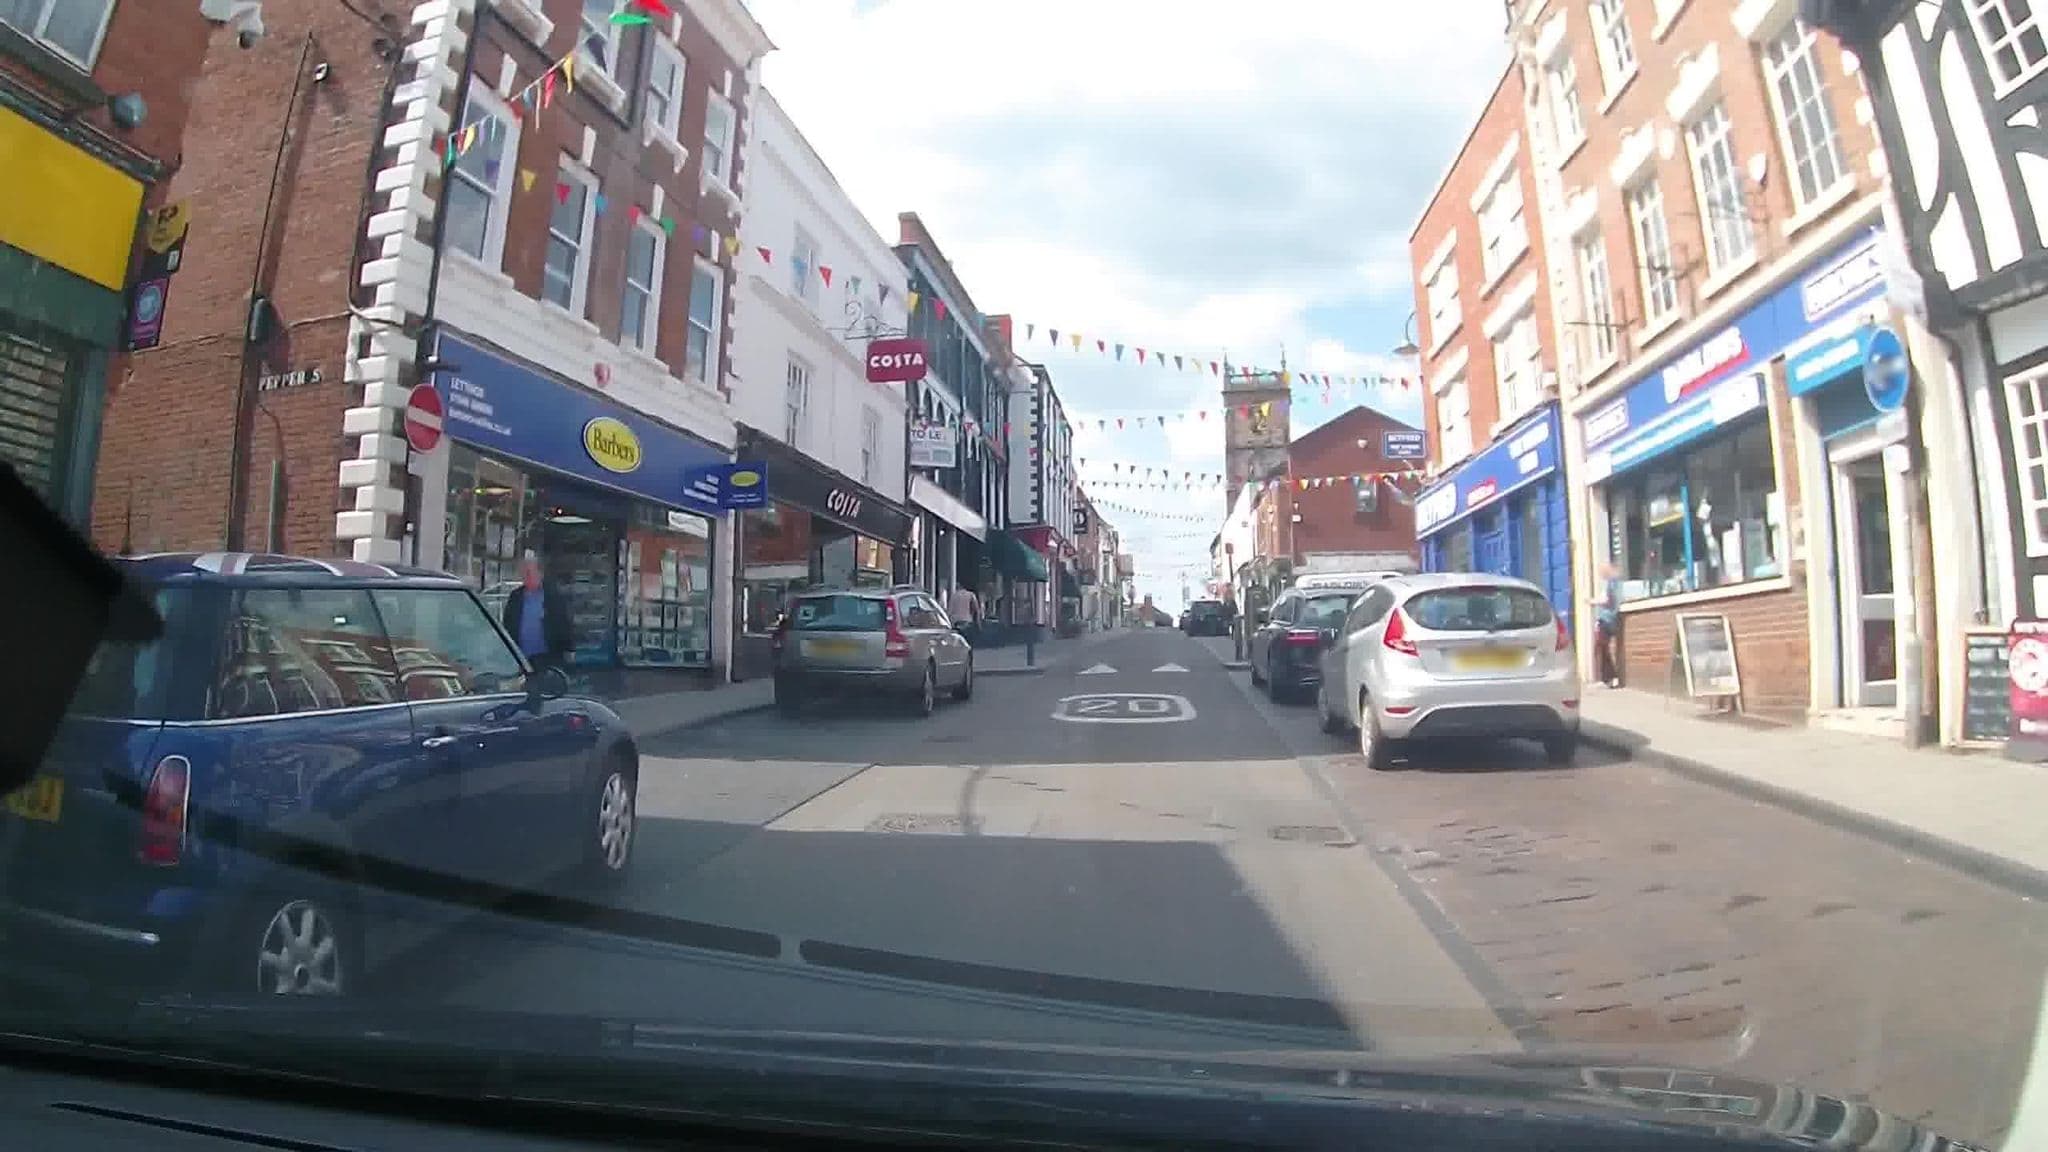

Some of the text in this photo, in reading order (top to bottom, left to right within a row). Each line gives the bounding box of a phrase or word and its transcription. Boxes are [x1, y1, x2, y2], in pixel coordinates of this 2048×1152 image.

[870, 352, 924, 369] COSTA
[911, 429, 926, 439] TO
[593, 428, 635, 463] Barbers
[827, 489, 861, 518] COSTA
[1078, 698, 1170, 713] 20
